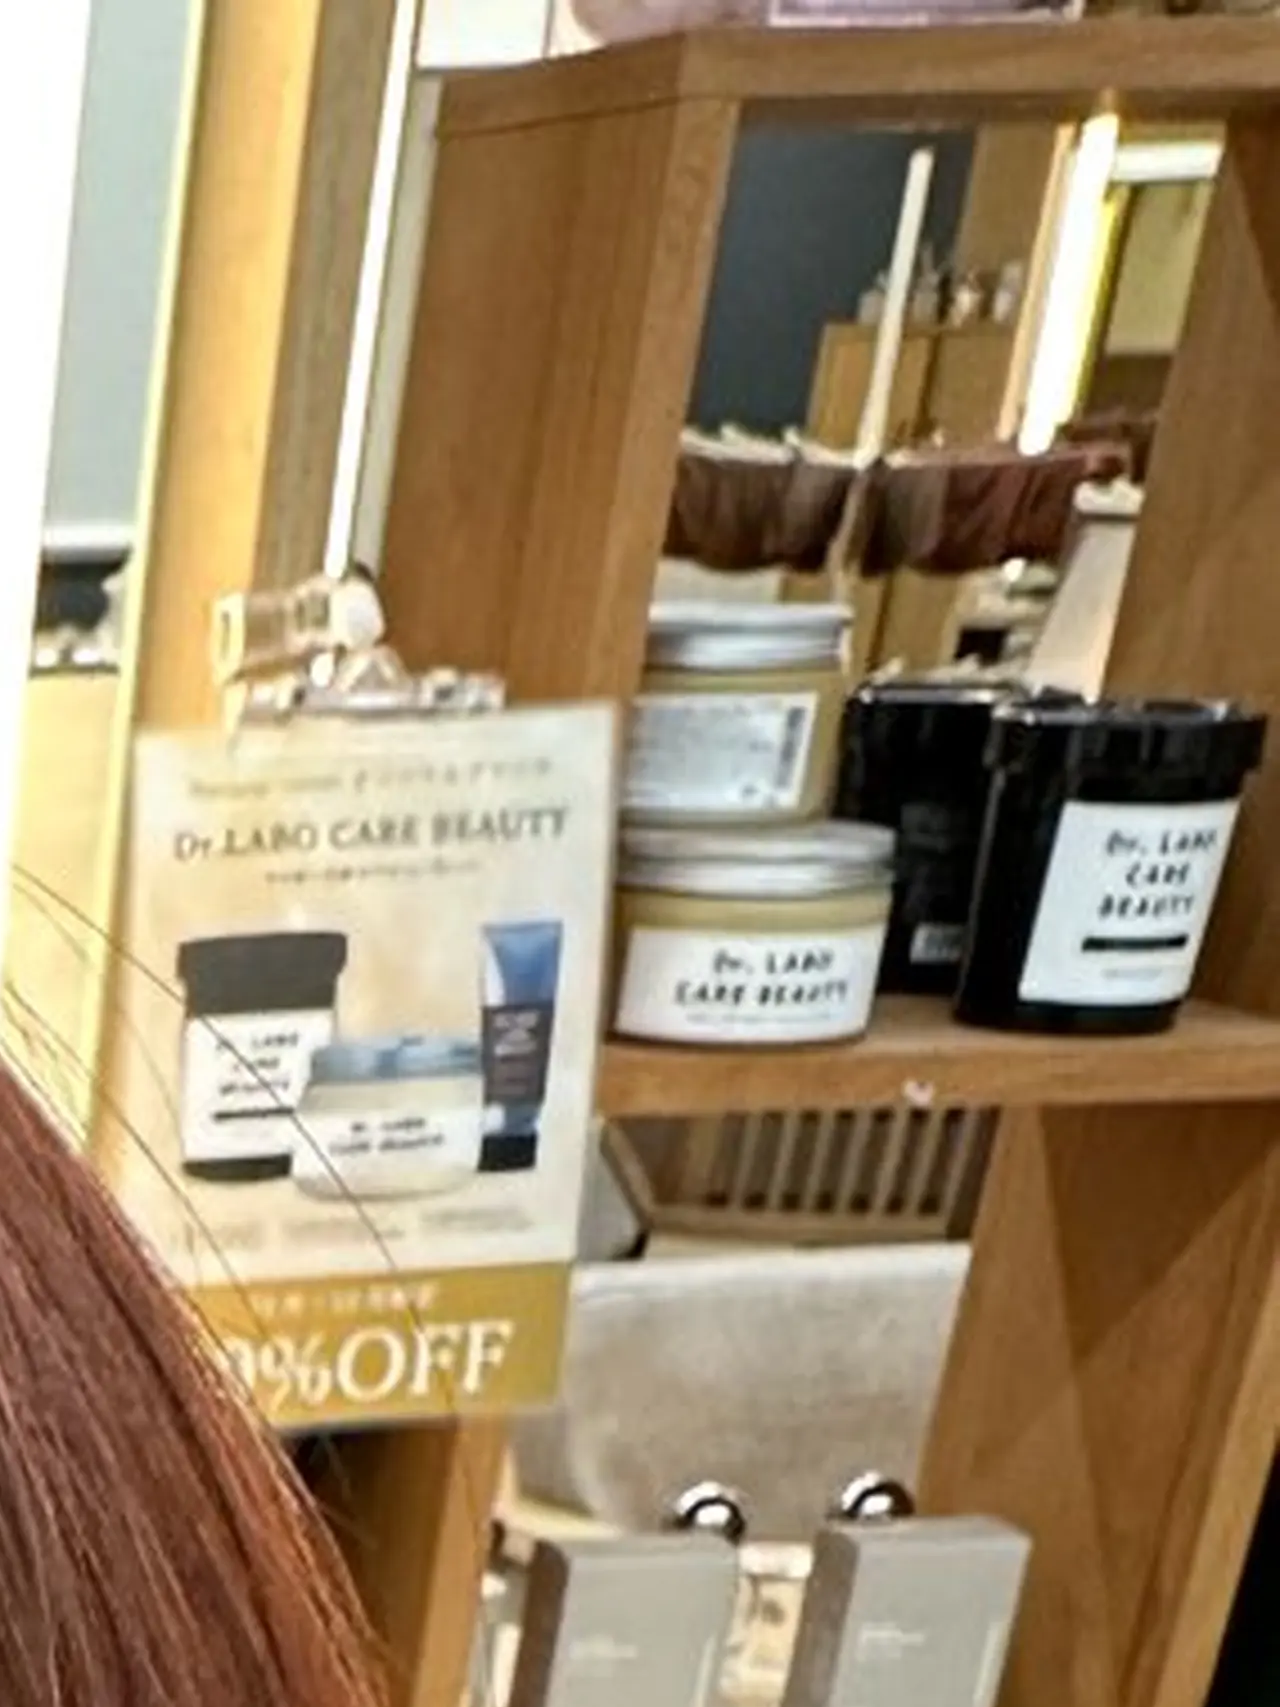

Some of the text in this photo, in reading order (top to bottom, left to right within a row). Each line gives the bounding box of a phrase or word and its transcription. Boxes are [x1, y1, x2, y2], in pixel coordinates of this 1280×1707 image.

[329, 812, 419, 851] CARE
[430, 804, 571, 846] BEAUTY
[1125, 861, 1191, 889] CARE
[1098, 894, 1196, 920] BEAUTY
[674, 978, 849, 1006] CARE BEAUTY
